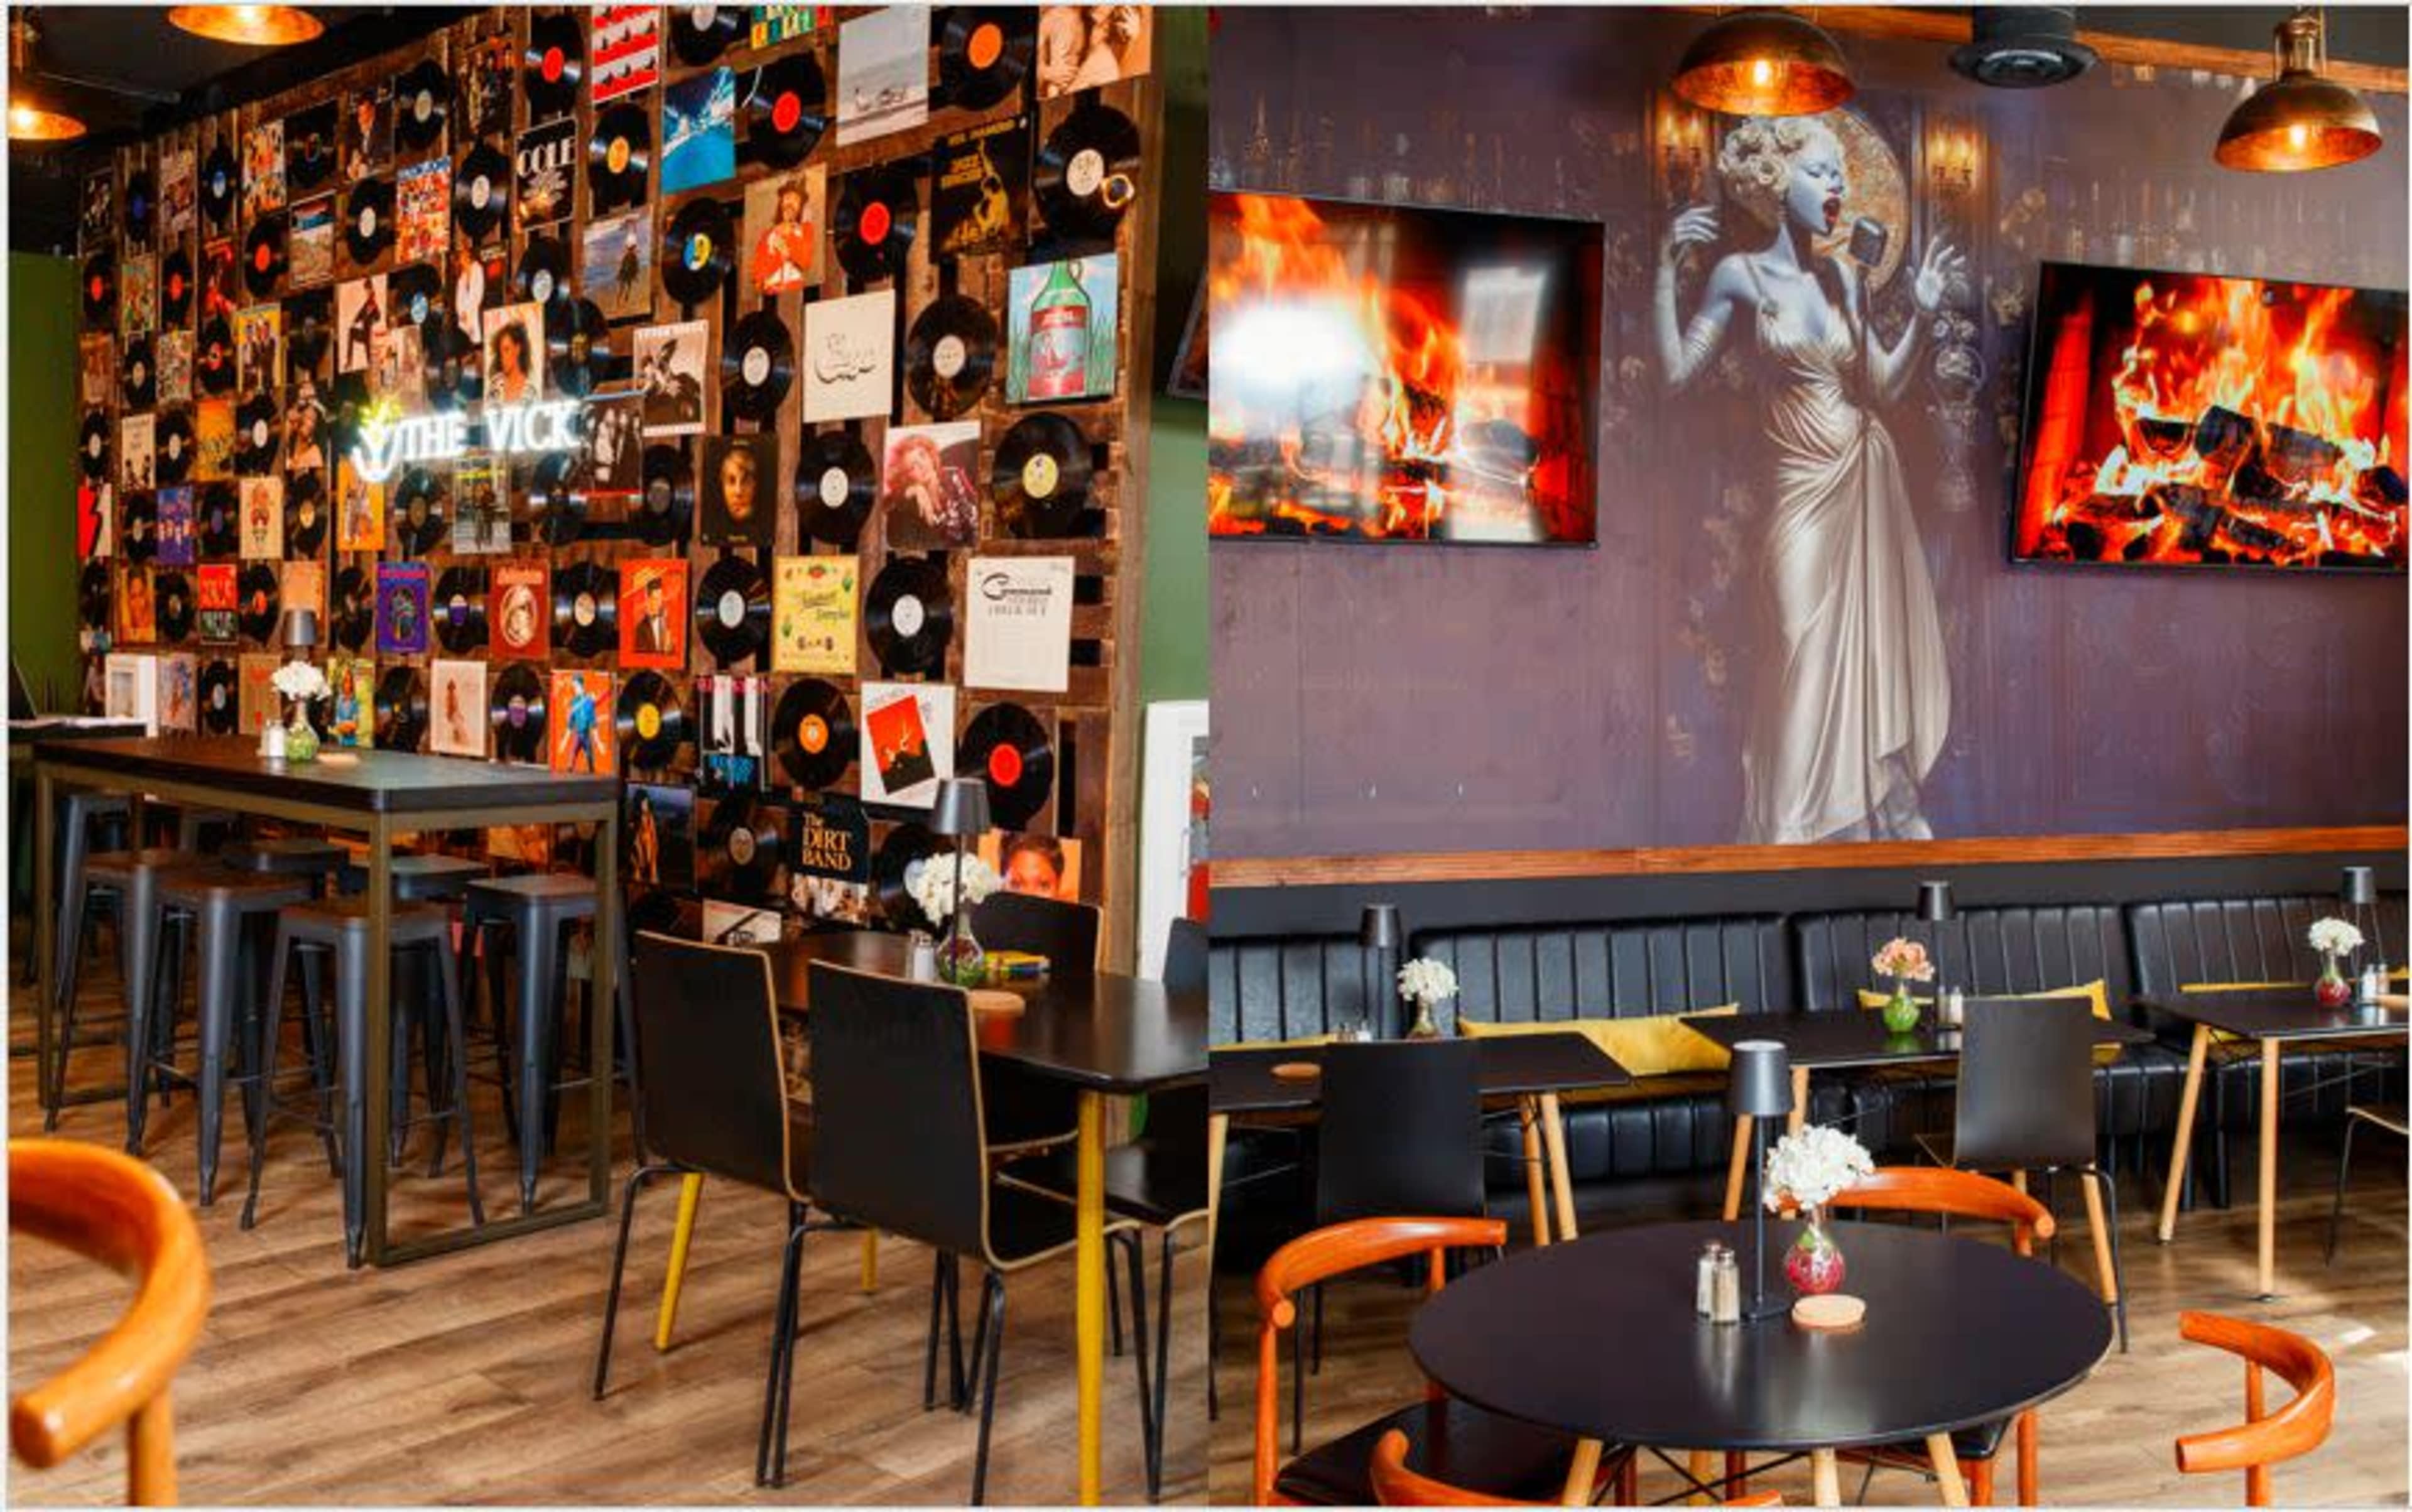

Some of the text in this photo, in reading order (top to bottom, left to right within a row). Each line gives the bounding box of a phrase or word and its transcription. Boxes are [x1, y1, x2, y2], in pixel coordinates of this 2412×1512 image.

[516, 136, 577, 178] COLE
[401, 398, 582, 460] THE VICK
[803, 826, 852, 851] DIRT
[803, 848, 852, 871] BAND
